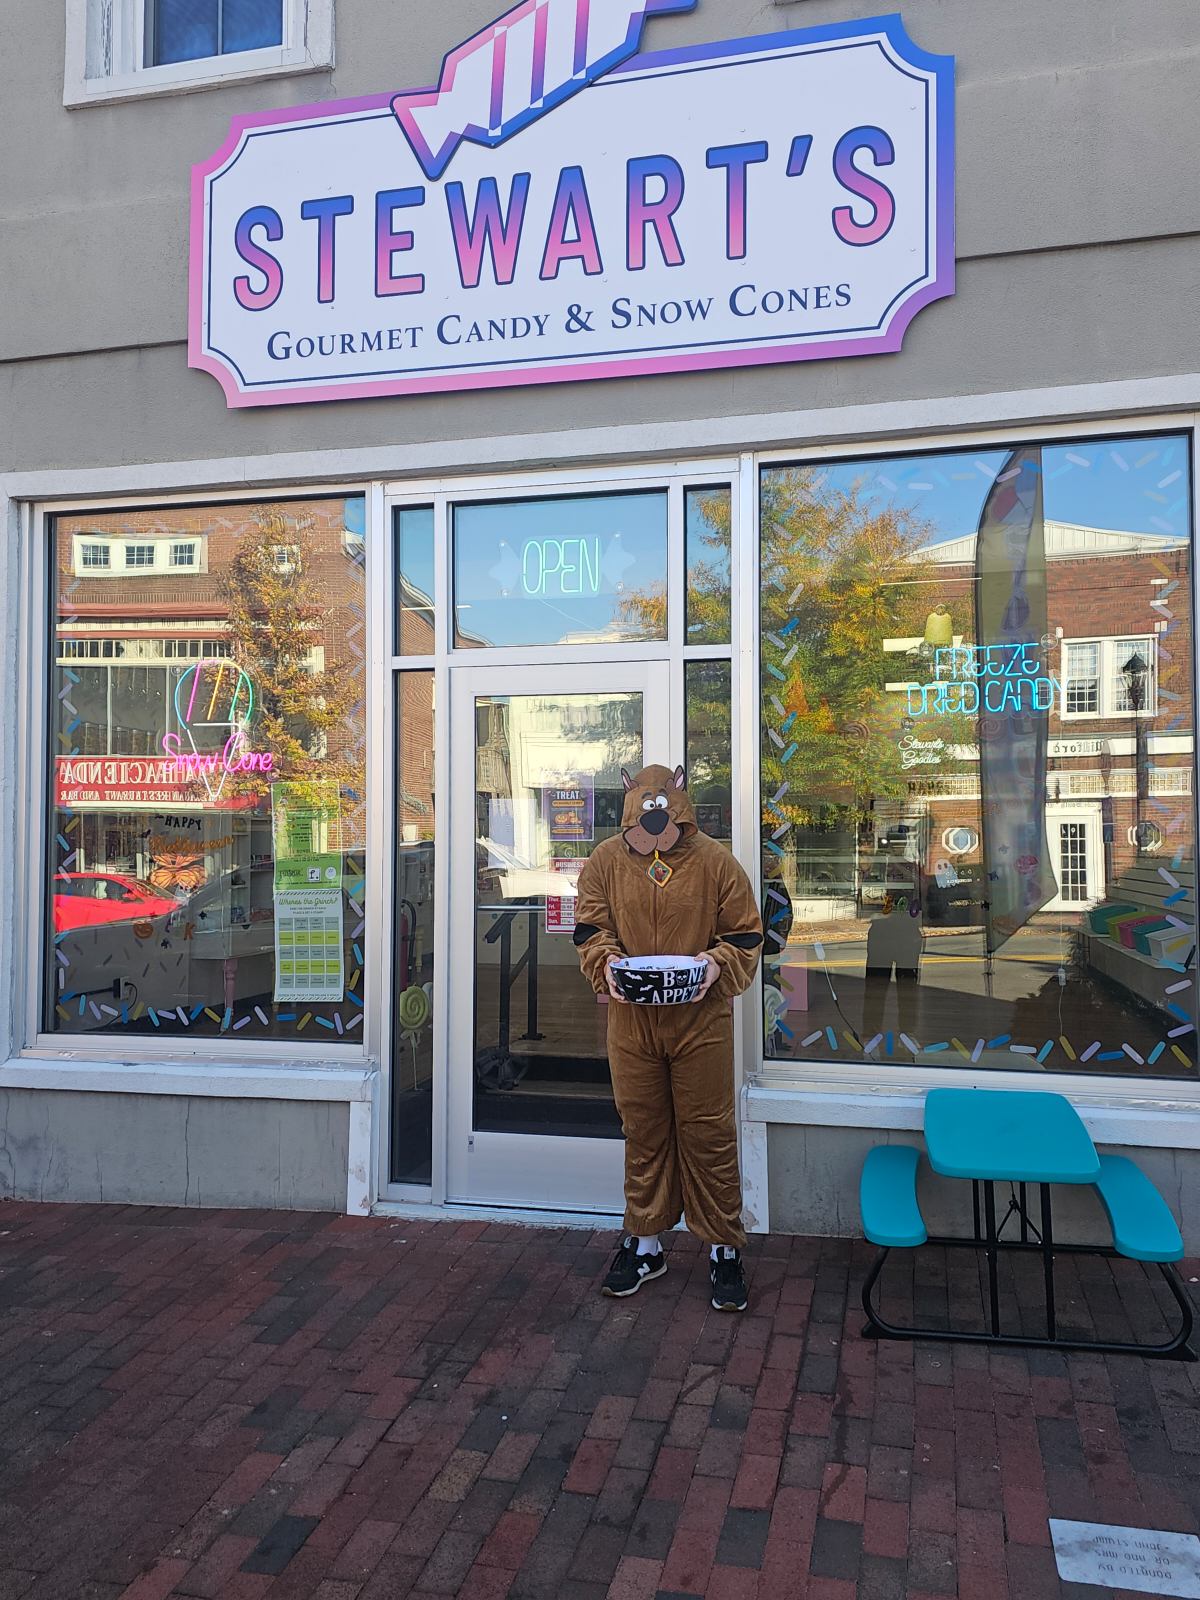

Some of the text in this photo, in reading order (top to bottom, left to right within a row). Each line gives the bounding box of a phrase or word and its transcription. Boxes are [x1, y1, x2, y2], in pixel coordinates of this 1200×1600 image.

[233, 125, 896, 312] STEWART'S
[267, 281, 852, 361] GOURMET CANDY & SNOW CONES
[523, 537, 599, 594] OPEN
[935, 642, 1040, 680] FREEZE
[907, 677, 1070, 716] DRIED CANDY
[162, 731, 273, 772] Snow Cone
[901, 750, 941, 770] Goodies
[556, 791, 580, 800] TREAT
[165, 815, 202, 831] HAPPY
[314, 897, 338, 907] Grinch?
